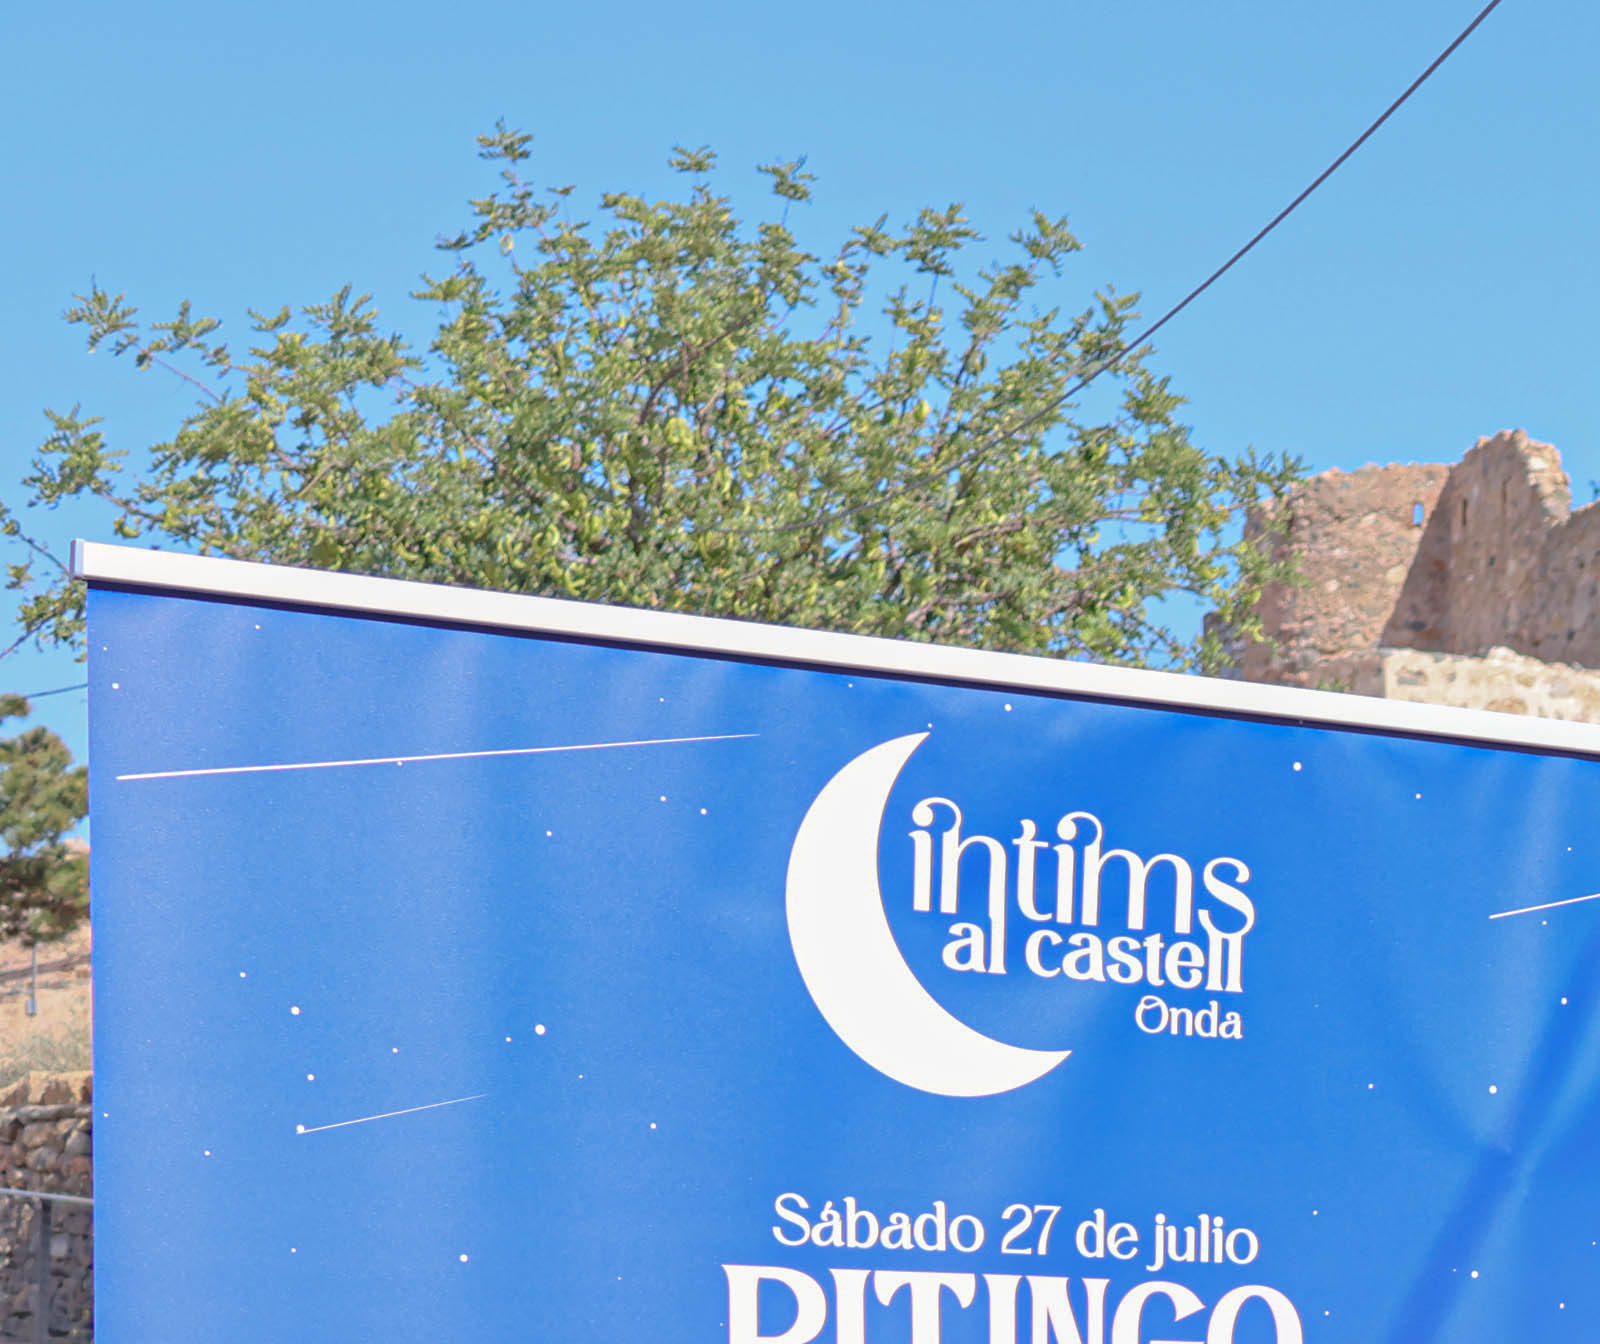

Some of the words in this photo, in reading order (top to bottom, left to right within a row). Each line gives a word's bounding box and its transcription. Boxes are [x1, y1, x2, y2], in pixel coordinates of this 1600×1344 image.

[942, 915, 1006, 974] al
[1025, 929, 1243, 992] castell
[1136, 995, 1242, 1039] Onda
[773, 1193, 984, 1252] Sábado
[1001, 1204, 1061, 1255] 27
[1076, 1208, 1138, 1259] de
[1146, 1214, 1258, 1271] julio
